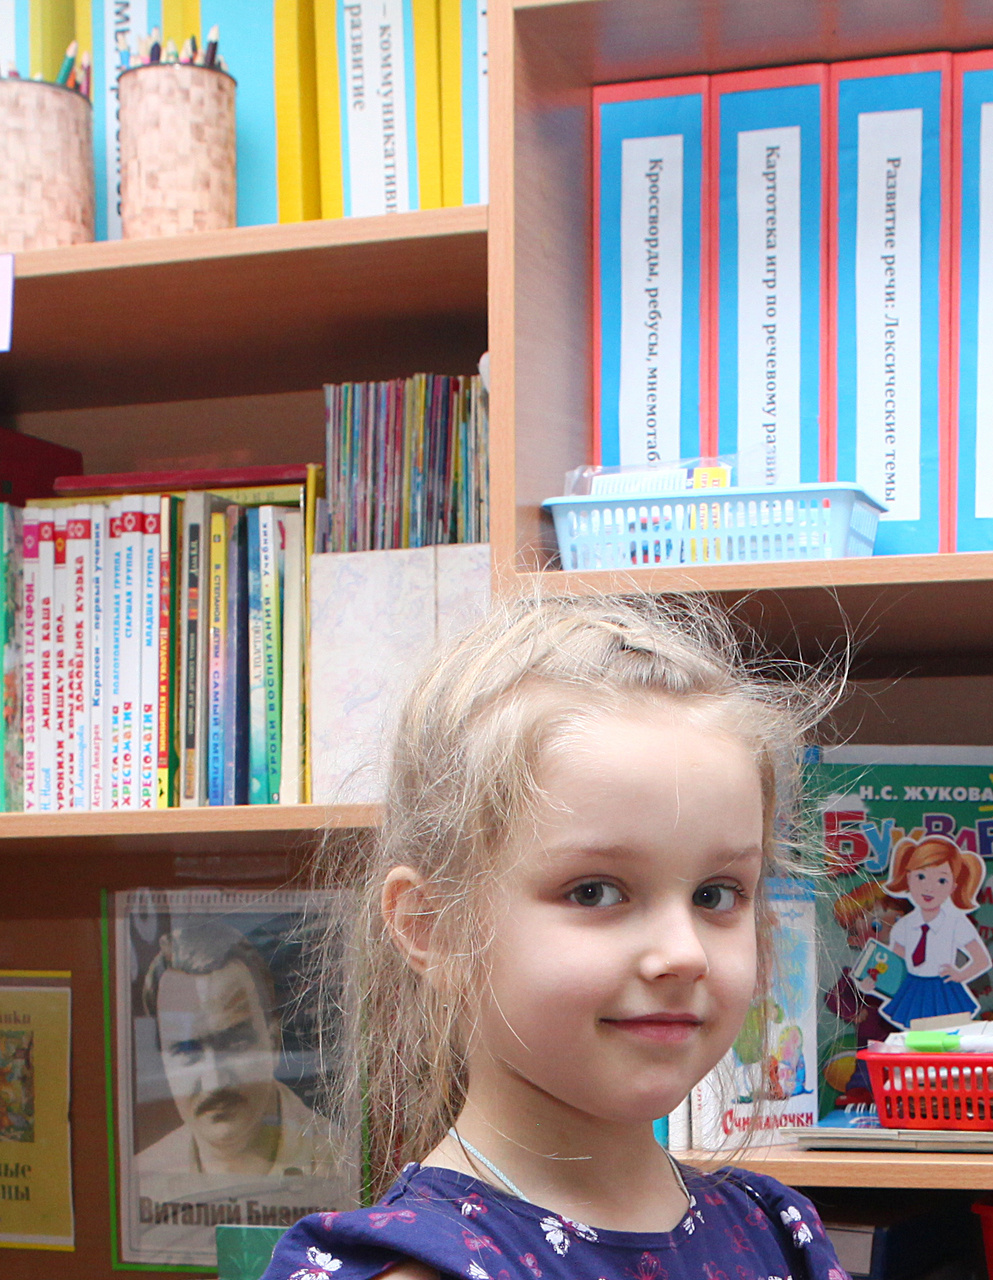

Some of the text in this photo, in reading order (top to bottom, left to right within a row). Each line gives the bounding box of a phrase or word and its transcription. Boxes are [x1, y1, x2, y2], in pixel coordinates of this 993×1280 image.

[344, 3, 366, 112] развитие
[644, 158, 664, 283] Кроссворды,
[762, 145, 781, 250] Картотека
[761, 255, 777, 290] игр
[644, 287, 664, 361] ребусы,
[765, 294, 777, 318] по
[881, 157, 902, 502] Развитие речи: Лексические темы
[761, 323, 777, 417] речевому
[93, 521, 102, 573] ученик
[125, 544, 133, 587] ГРУППА
[146, 547, 155, 589] ГРУППА
[92, 576, 102, 630] первый
[125, 590, 133, 640] СТАРШАЯ
[146, 592, 155, 648] МЛАДШАЯ
[213, 575, 222, 623] СТЕПАНОВ
[92, 646, 102, 708] Карлсон
[261, 522, 278, 775] УРОКИ ВОСПИТАНИЯ Учебник
[212, 670, 223, 727] САМЫЙ
[91, 724, 104, 808] Астрид Линдгрен
[212, 732, 223, 800] СМЕЛЫЙ
[139, 1196, 242, 1227] Виталий
